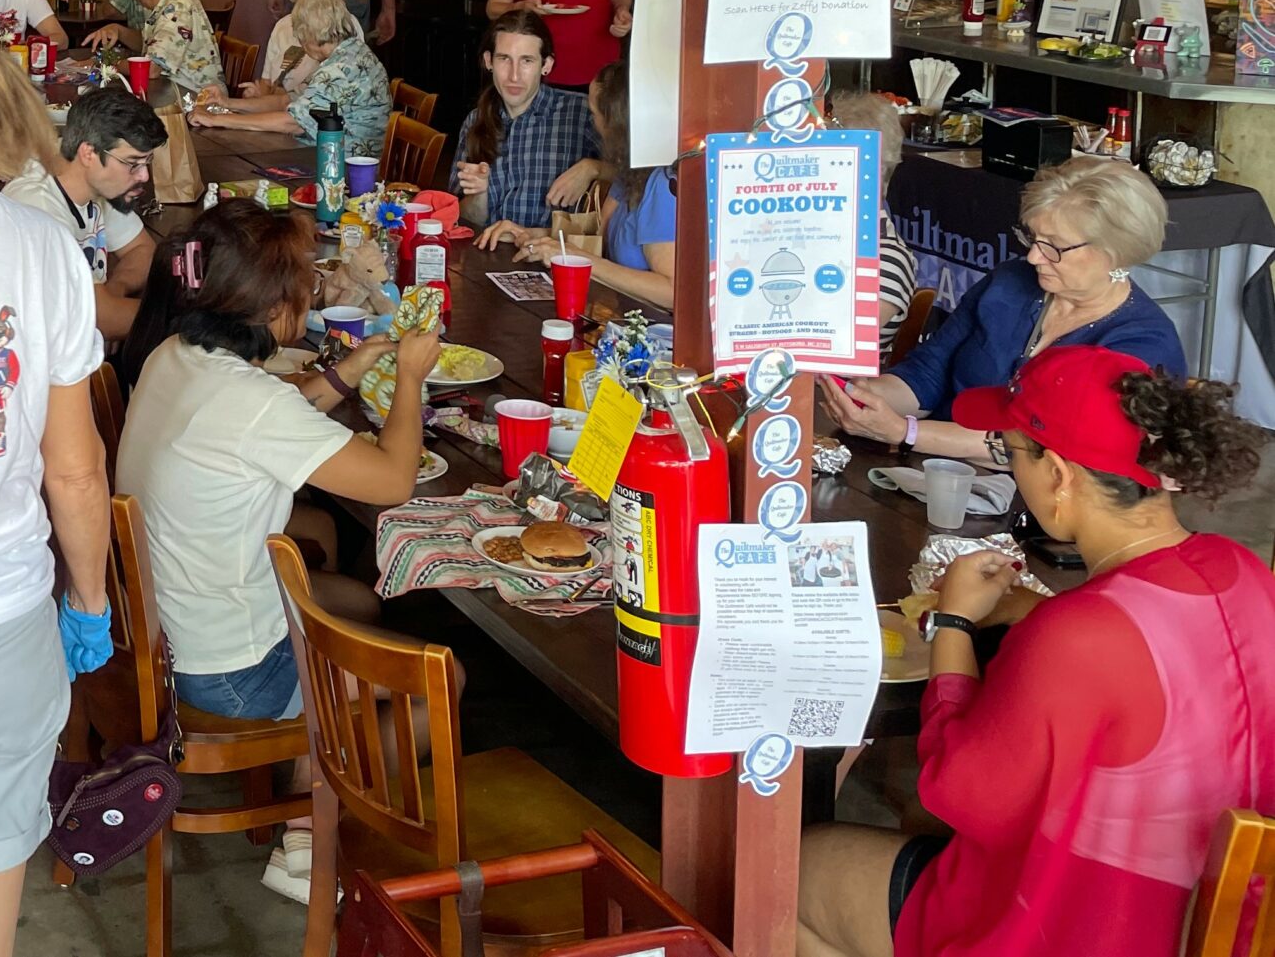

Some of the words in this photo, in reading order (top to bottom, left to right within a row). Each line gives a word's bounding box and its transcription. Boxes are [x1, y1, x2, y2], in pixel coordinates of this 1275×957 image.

[724, 6, 748, 14] Scan
[750, 4, 776, 12] HERE
[778, 3, 791, 13] for
[791, 0, 819, 13] Zeffy
[821, 1, 869, 10] Donation
[754, 152, 820, 183] Quiltmaker
[735, 184, 785, 194] FOURTH
[787, 183, 803, 192] OF
[805, 182, 838, 191] JULY
[728, 195, 847, 215] COOKOUT
[755, 416, 801, 477] Q
[760, 483, 805, 543] Q
[742, 734, 792, 794] Q
